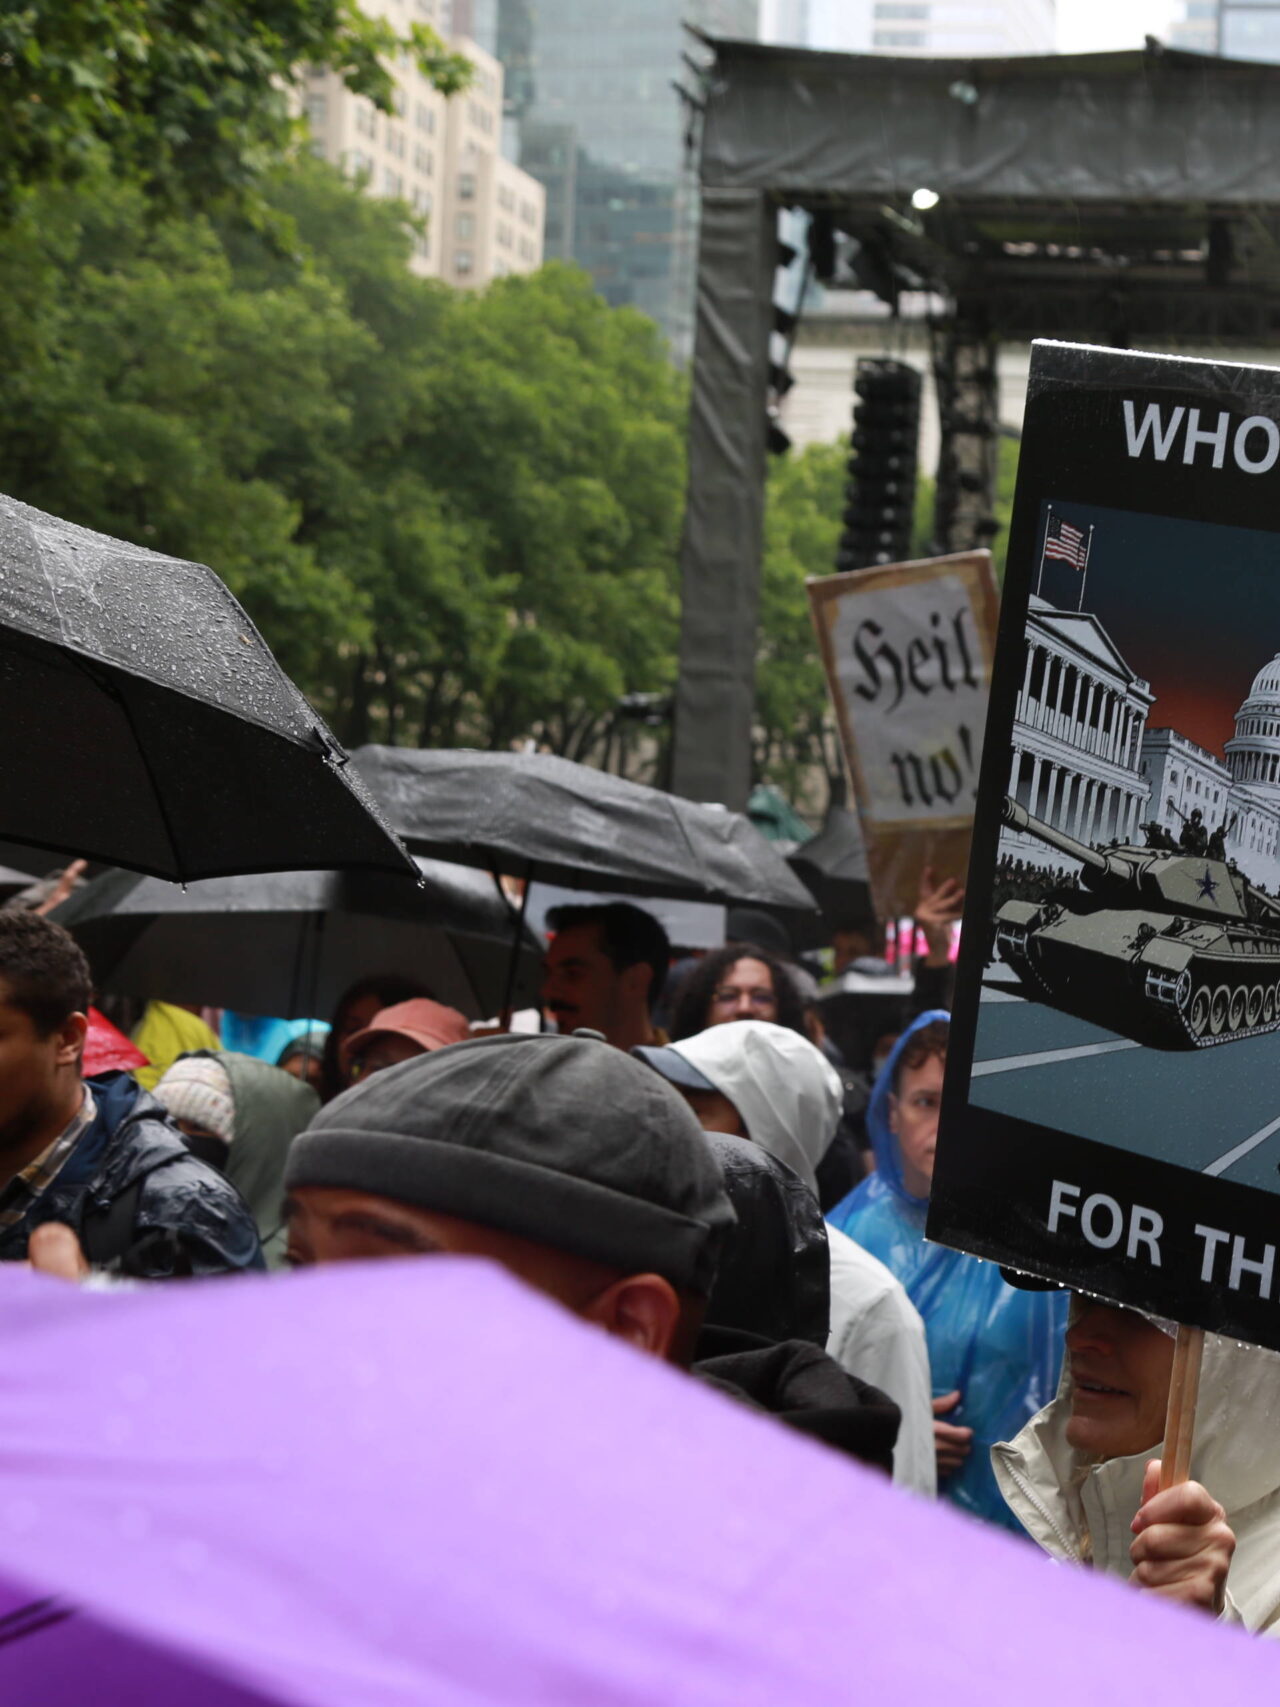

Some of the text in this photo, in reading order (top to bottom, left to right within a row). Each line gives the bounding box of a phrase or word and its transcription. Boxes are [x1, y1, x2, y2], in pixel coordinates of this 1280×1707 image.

[1122, 400, 1280, 474] WHO
[852, 605, 980, 714] Heil
[891, 722, 978, 809] no!
[1047, 1179, 1164, 1267] FOR
